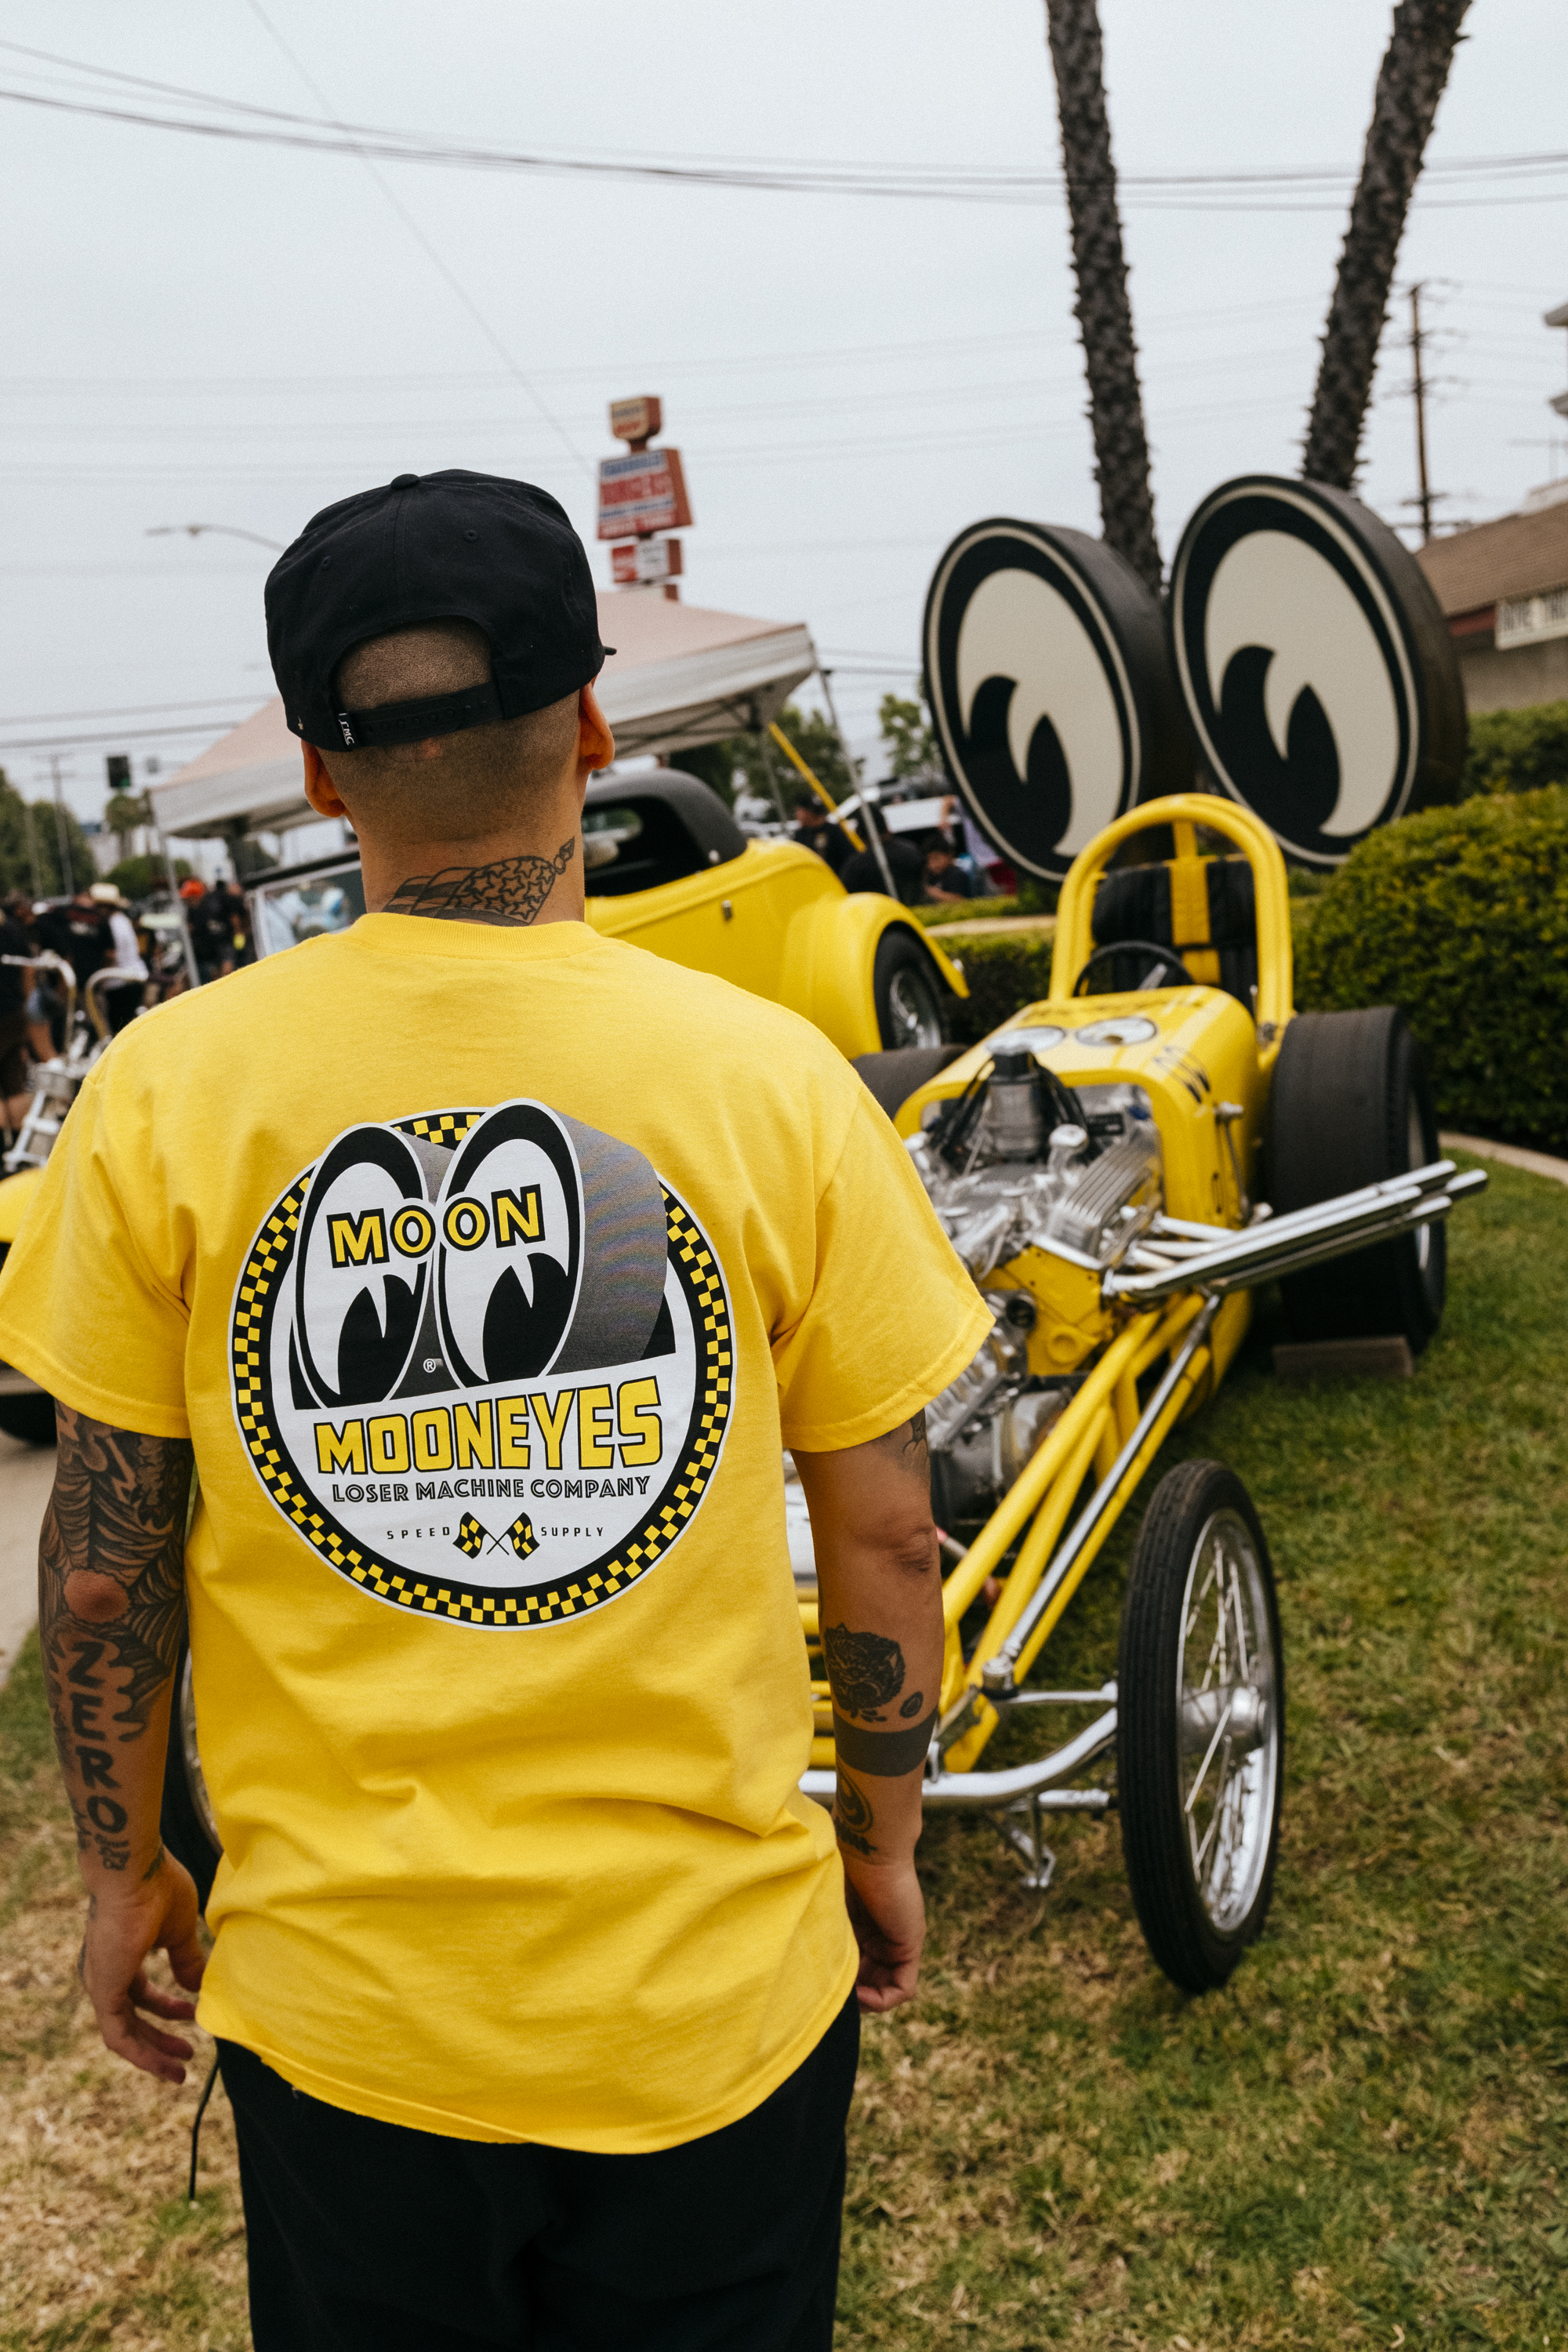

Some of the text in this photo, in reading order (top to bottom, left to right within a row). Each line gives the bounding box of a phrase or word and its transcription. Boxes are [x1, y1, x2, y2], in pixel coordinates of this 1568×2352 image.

[326, 1183, 546, 1269] MOON
[313, 1375, 663, 1475] MOONEYES
[332, 1475, 651, 1503] LOSER MACHINE COMPANY
[387, 1526, 604, 1540] SPEED SUPPLY
[67, 1640, 129, 1835] ZERO
